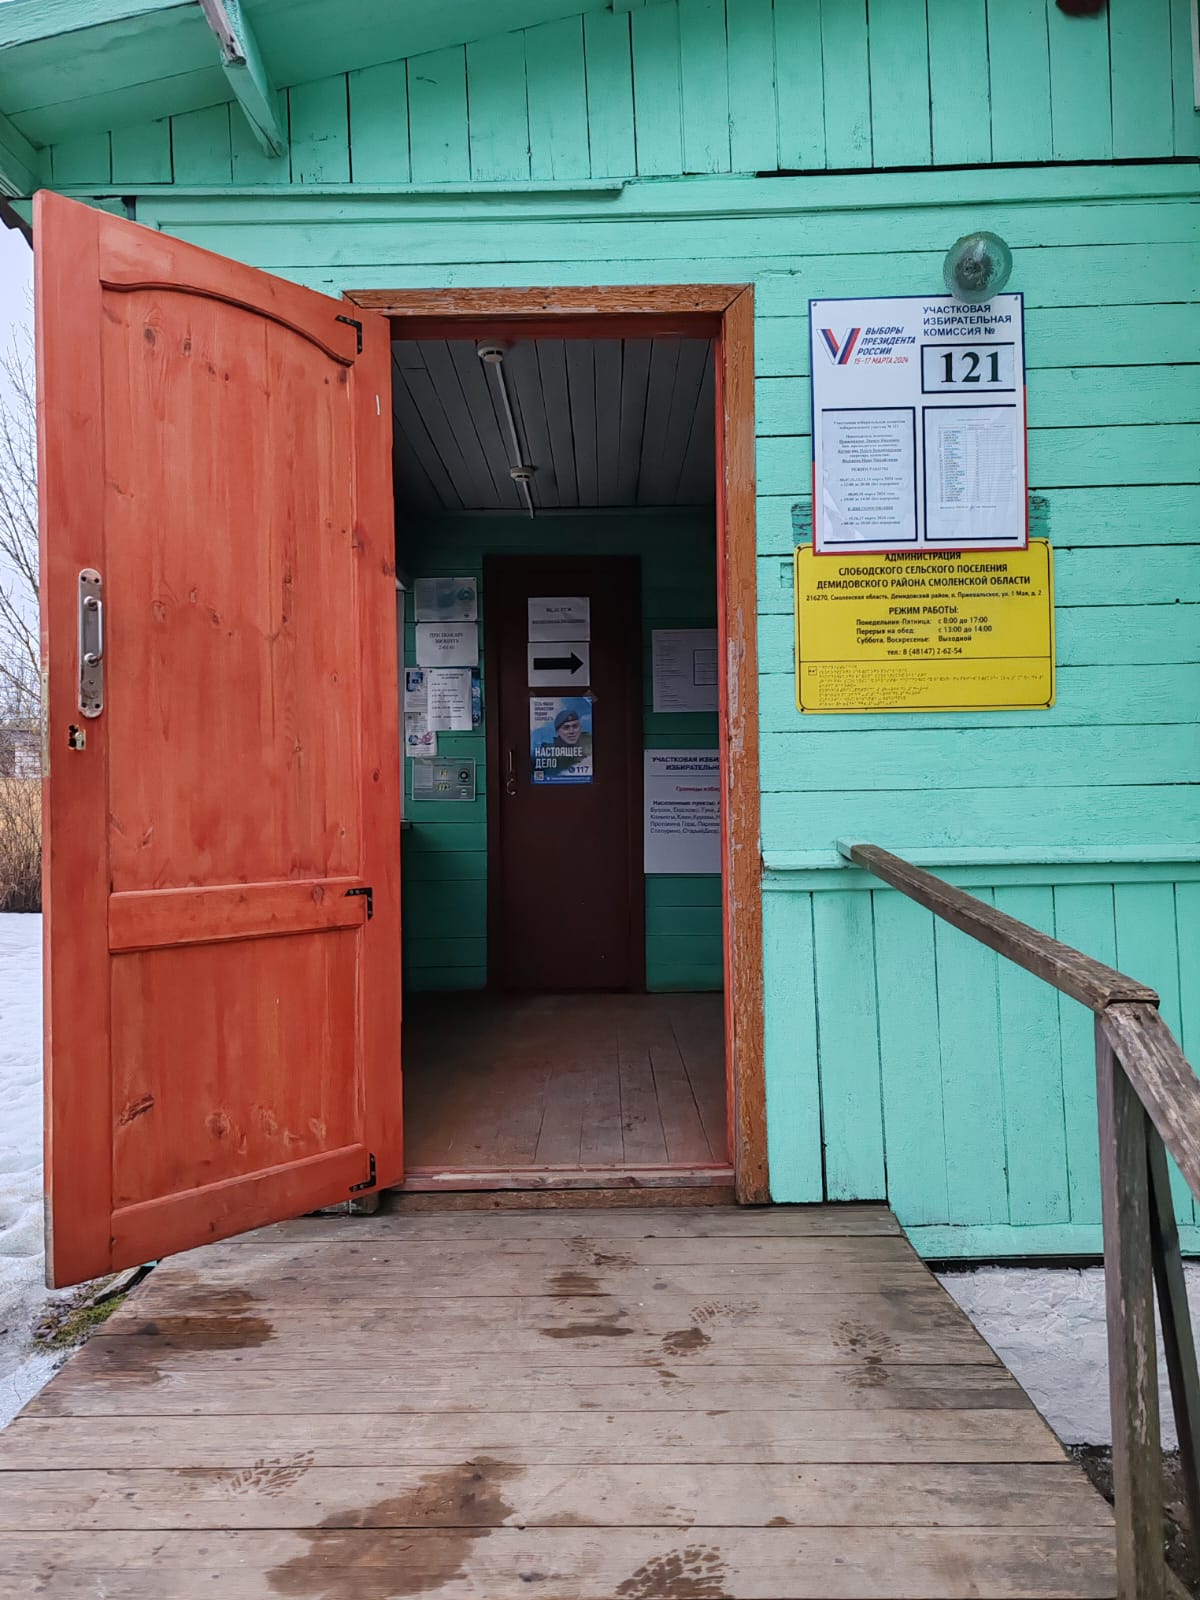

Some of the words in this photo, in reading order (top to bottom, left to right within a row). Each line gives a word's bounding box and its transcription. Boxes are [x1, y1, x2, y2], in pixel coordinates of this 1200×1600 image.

[923, 304, 991, 314] УЧАСТКОВАЯ
[923, 315, 1012, 325] ИЗБИРАТЕЛЬНАЯ
[865, 326, 905, 335] ВЫБОРЫ
[923, 327, 982, 336] КОМИССИЯ
[984, 326, 996, 335] №
[861, 336, 916, 346] ПРЕЗИДЕНТА
[857, 347, 893, 356] РОССИИ
[872, 356, 893, 364] МАРТА
[893, 355, 909, 364] 2024
[940, 351, 1003, 383] 121
[885, 552, 961, 561] АДМИНИСТРАЦИЯ
[839, 566, 903, 576] СЛОБОДСКОГО
[905, 565, 955, 575] СЕЛЬСКОГО
[957, 563, 1008, 573] ПОСЕЛЕНИЯ
[817, 579, 889, 590] ДЕМИДОВСКОГО
[891, 577, 926, 587] РАЙОНА
[928, 576, 988, 586] СМОЛЕНСКОЙ
[990, 576, 1031, 585] ОБЛАСТИ
[888, 606, 920, 615] РЕЖИМ
[922, 605, 959, 614] РАБОТЫ:
[970, 616, 988, 624] 17:00
[856, 627, 886, 635] Перерыв
[909, 647, 935, 656] (48147)
[936, 647, 962, 655] 2-62-54
[535, 746, 583, 757] НАСТОЯЩЕЕ
[535, 758, 557, 769] ДЕЛО
